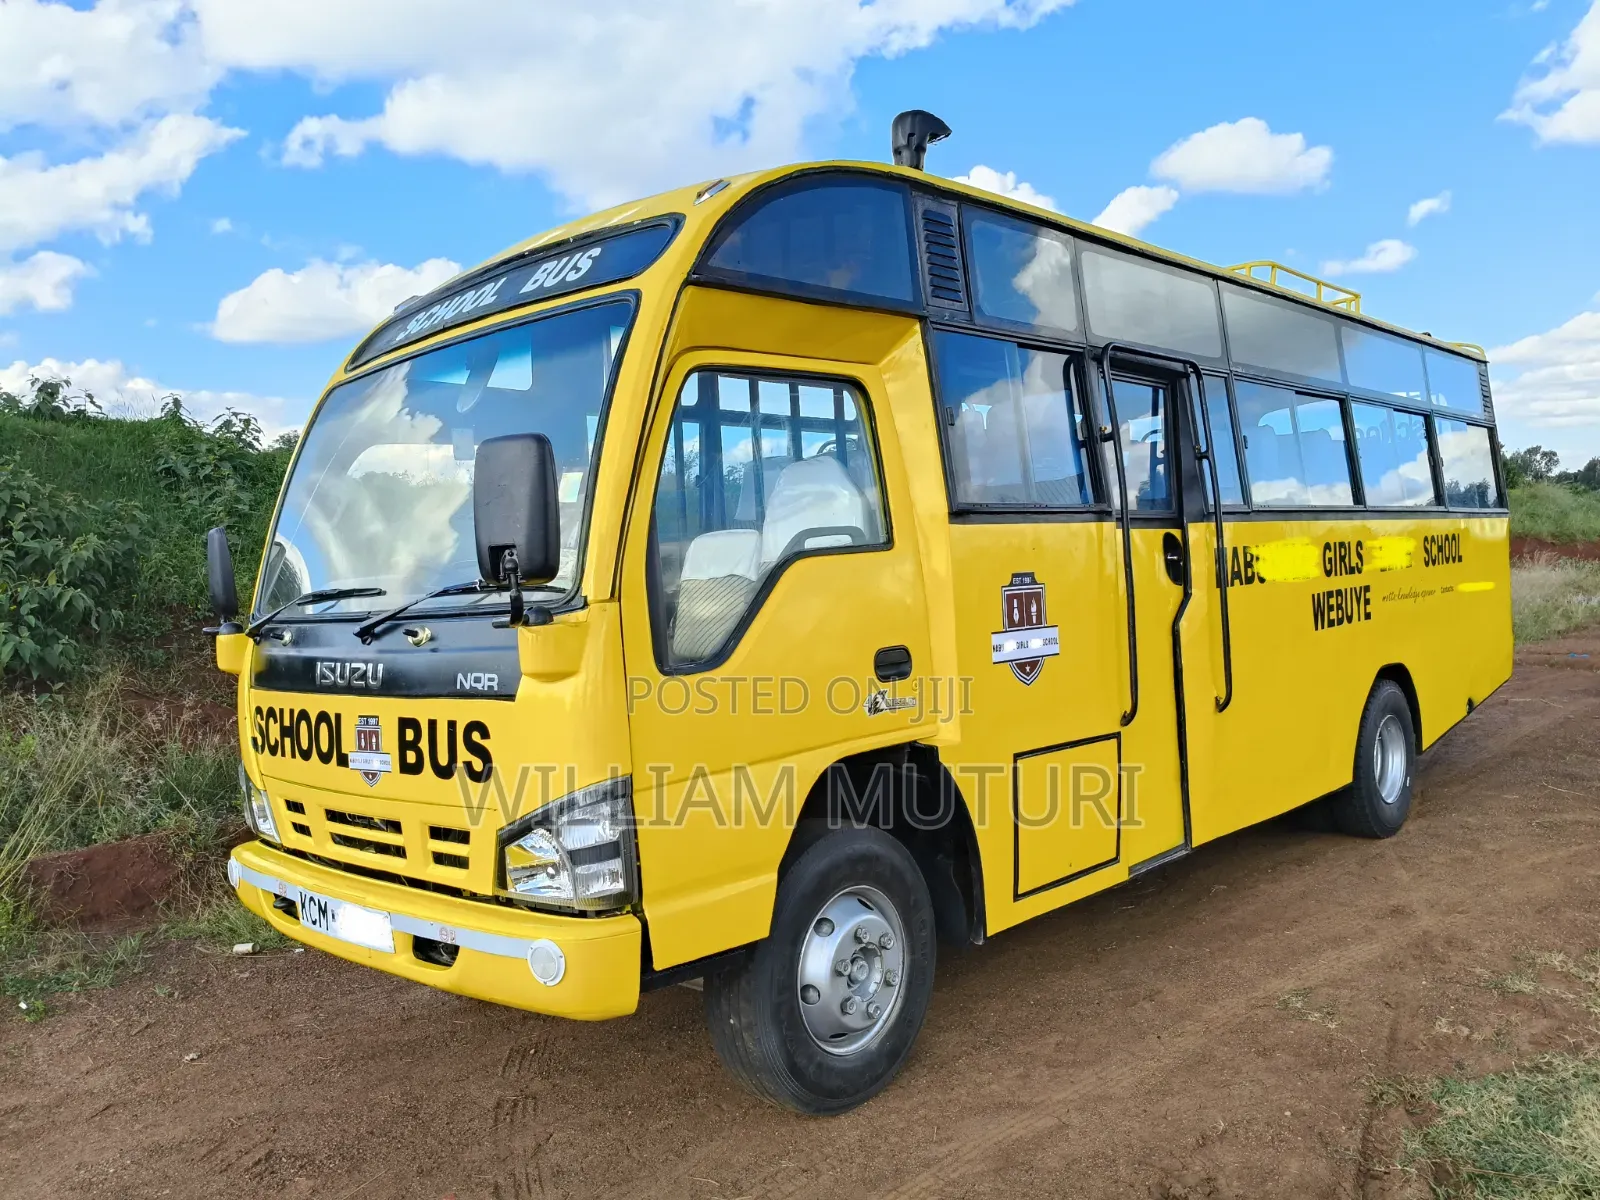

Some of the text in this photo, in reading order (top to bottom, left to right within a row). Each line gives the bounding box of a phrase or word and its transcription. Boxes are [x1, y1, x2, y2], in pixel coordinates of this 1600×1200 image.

[396, 248, 602, 341] SCHOOL BUS
[1322, 540, 1364, 578] GIRLS
[1423, 533, 1463, 568] SCHOOL
[1311, 585, 1371, 631] WEBUYE
[316, 662, 384, 688] ISUZU
[456, 672, 498, 691] NQR
[251, 706, 493, 783] SCHOOL BUS
[299, 891, 329, 931] KCM
